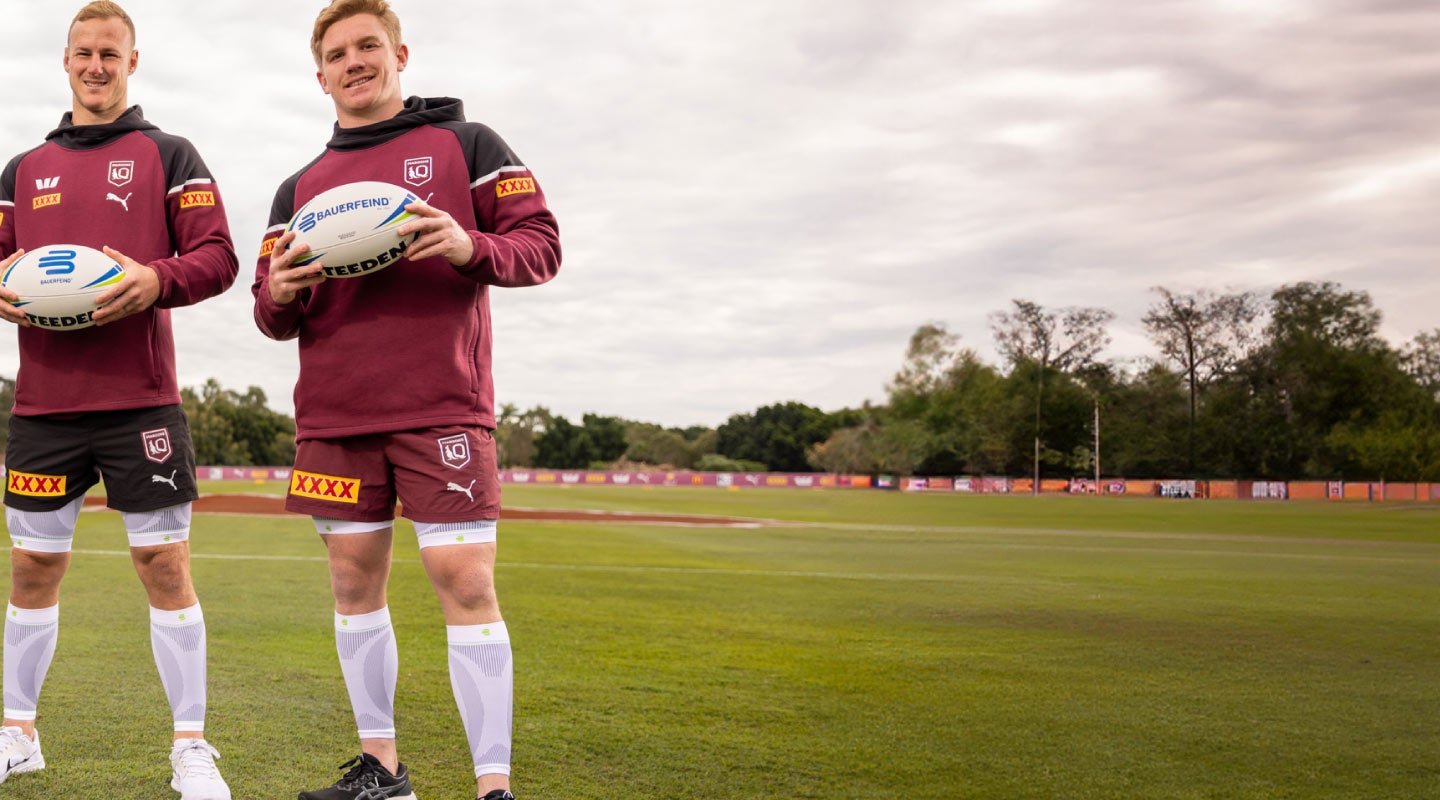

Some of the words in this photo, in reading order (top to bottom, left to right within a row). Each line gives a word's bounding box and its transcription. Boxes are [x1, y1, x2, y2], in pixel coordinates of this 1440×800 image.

[498, 179, 533, 194] XXXX
[34, 194, 58, 207] XXXX
[182, 193, 213, 206] XXXX
[316, 197, 390, 221] BAUERFEIND
[24, 306, 102, 327] TEEDE
[10, 473, 61, 493] XXXX
[295, 474, 356, 499] XXXX
